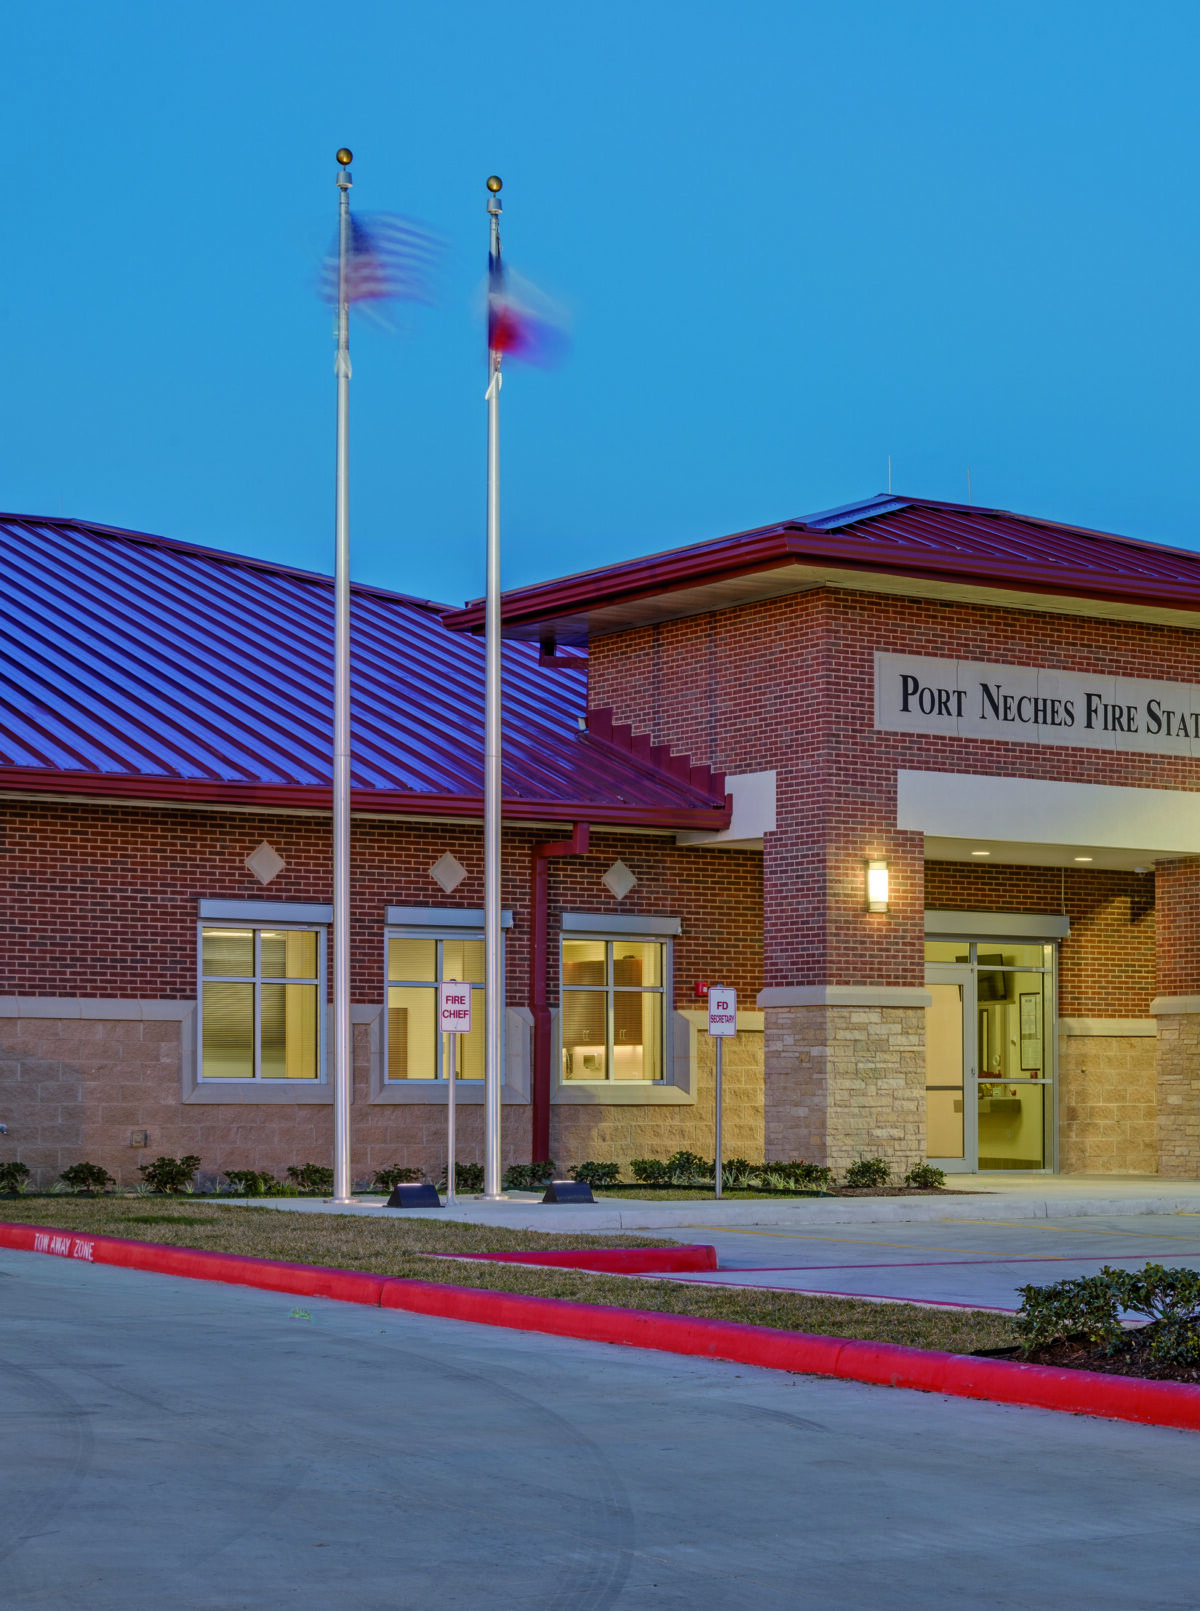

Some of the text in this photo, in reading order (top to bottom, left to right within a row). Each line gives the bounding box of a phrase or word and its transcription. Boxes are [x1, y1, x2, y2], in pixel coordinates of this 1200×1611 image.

[899, 674, 967, 718] PORT
[979, 682, 1075, 727] NECHES
[1084, 692, 1138, 733] FIRE
[445, 995, 467, 1005] FIRE
[716, 1001, 729, 1010] FD
[442, 1009, 469, 1019] CHIEF
[34, 1233, 95, 1261] TOW AWAY ZONE
